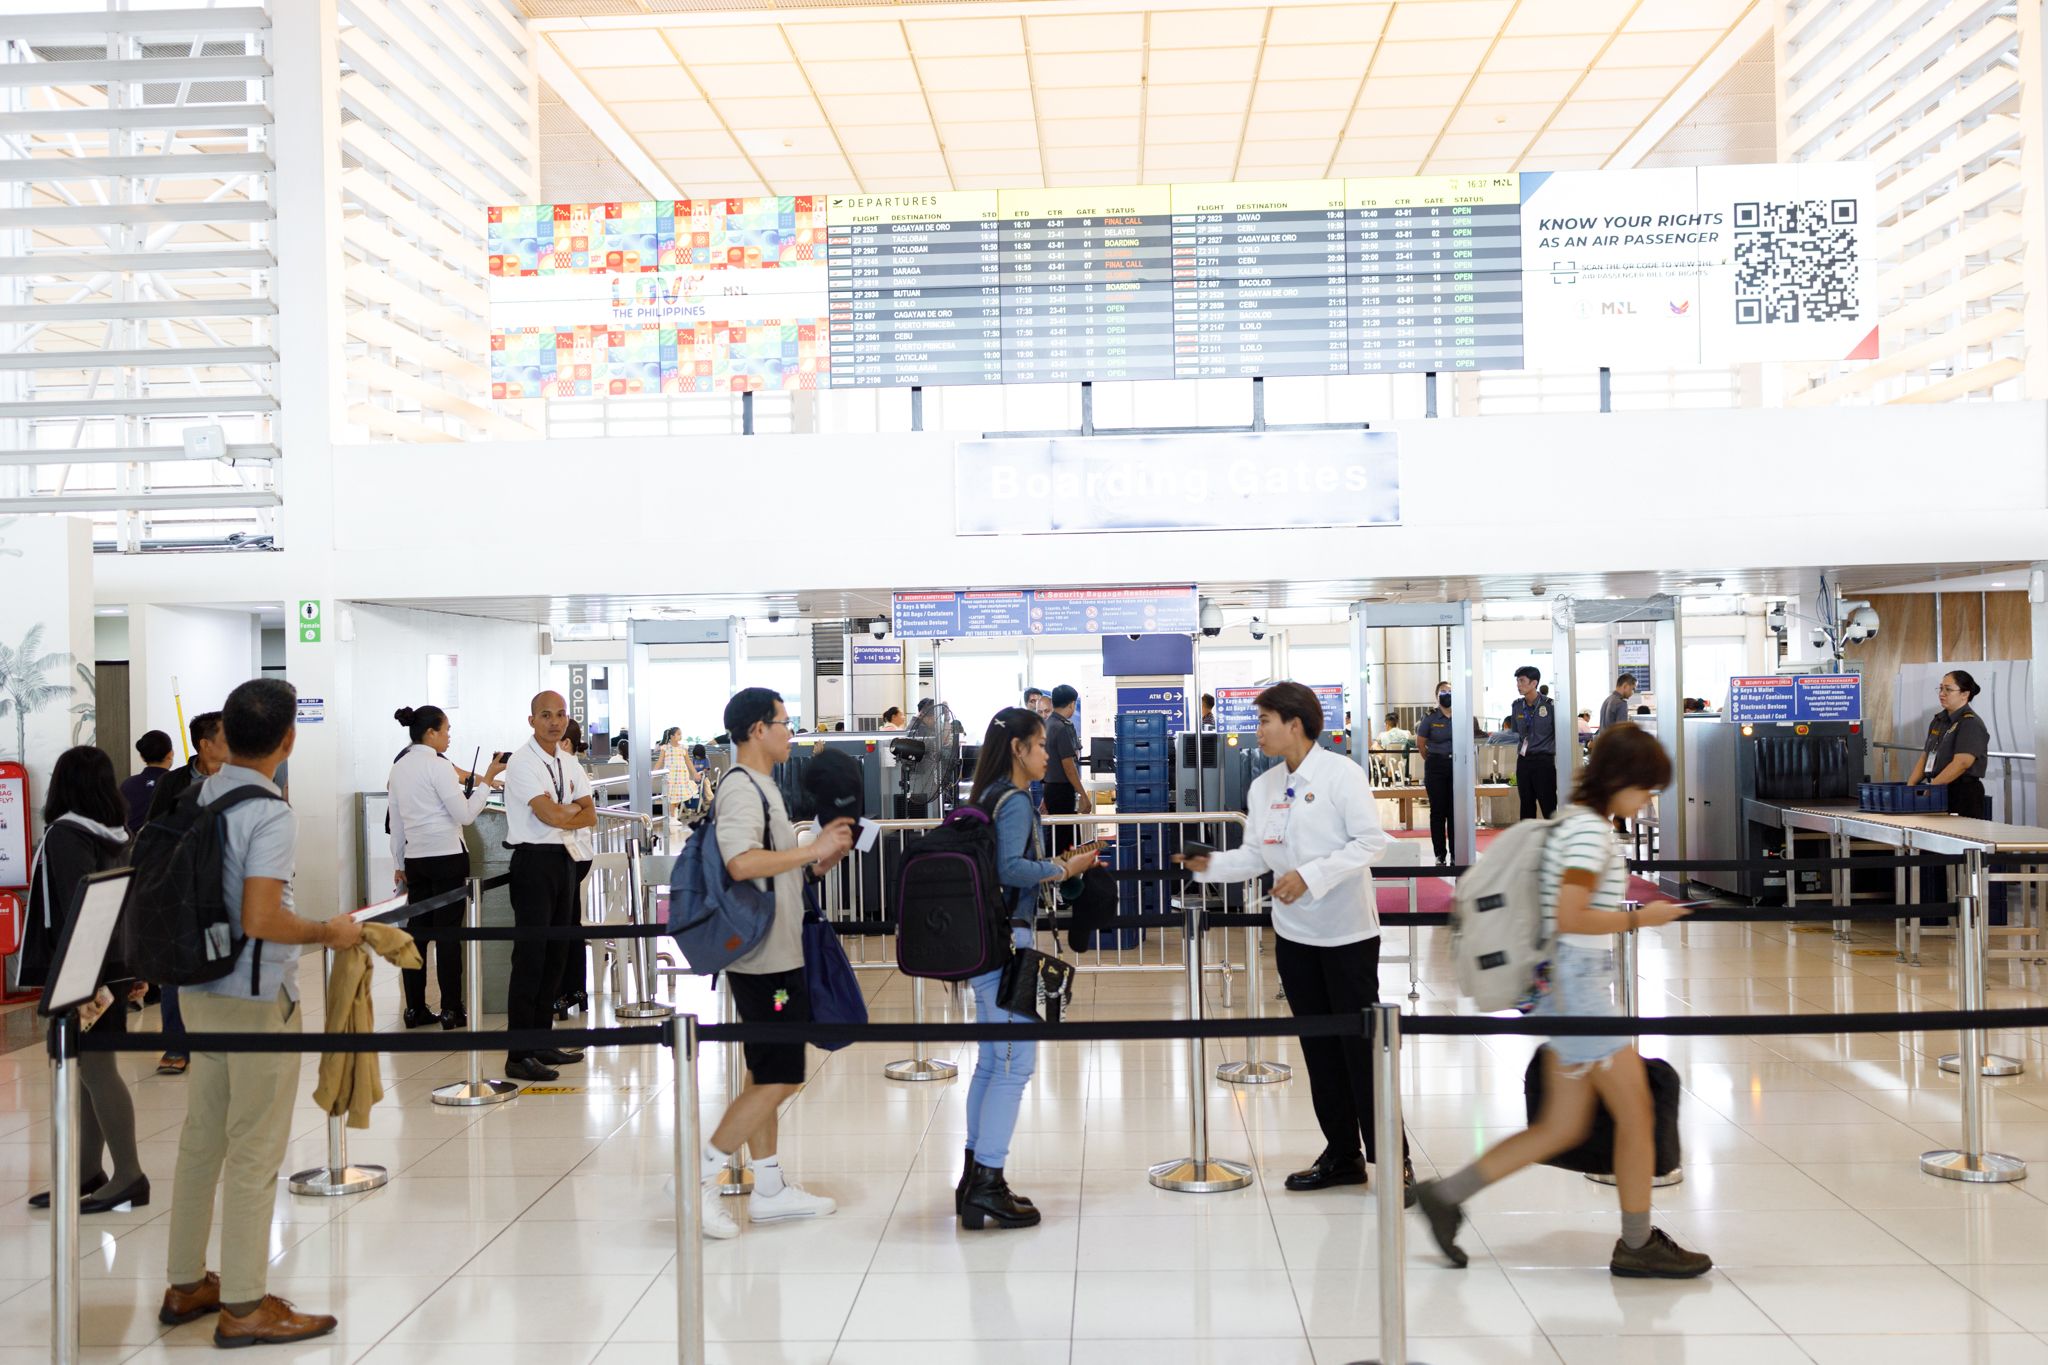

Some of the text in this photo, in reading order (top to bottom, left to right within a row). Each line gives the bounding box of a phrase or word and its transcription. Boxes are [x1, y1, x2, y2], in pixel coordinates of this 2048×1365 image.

[848, 196, 937, 208] DEPARTURES
[1452, 207, 1471, 215] OPEN
[892, 224, 924, 232] CAGAYAN
[980, 222, 997, 230] 16:10
[1539, 213, 1723, 231] KNOW YOUR RIGHTS
[1104, 228, 1135, 236] DELAYED
[1237, 235, 1270, 243] CAGAYAN
[1282, 234, 1297, 242] ORO
[1539, 232, 1719, 248] AS AN AIR PASSENGER
[892, 246, 928, 254] TACLOBAN
[1105, 239, 1139, 247] BOARDING
[1014, 264, 1031, 272] 16:55
[1105, 261, 1124, 269] FINAL
[1125, 260, 1143, 268] CALL
[1238, 257, 1256, 265] CEBU
[612, 276, 704, 307] LOVE
[894, 289, 921, 297] BUTUAN
[1106, 282, 1140, 290] BOARDING
[612, 307, 705, 318] THE PHILIPPINES
[1016, 307, 1032, 315] 17:35
[1106, 304, 1125, 312] OPEN
[1240, 322, 1262, 330] ILOILO
[895, 332, 912, 340] CEBU
[990, 458, 1368, 501] Boarding Gates
[573, 668, 583, 684] LG
[573, 689, 584, 723] OLED
